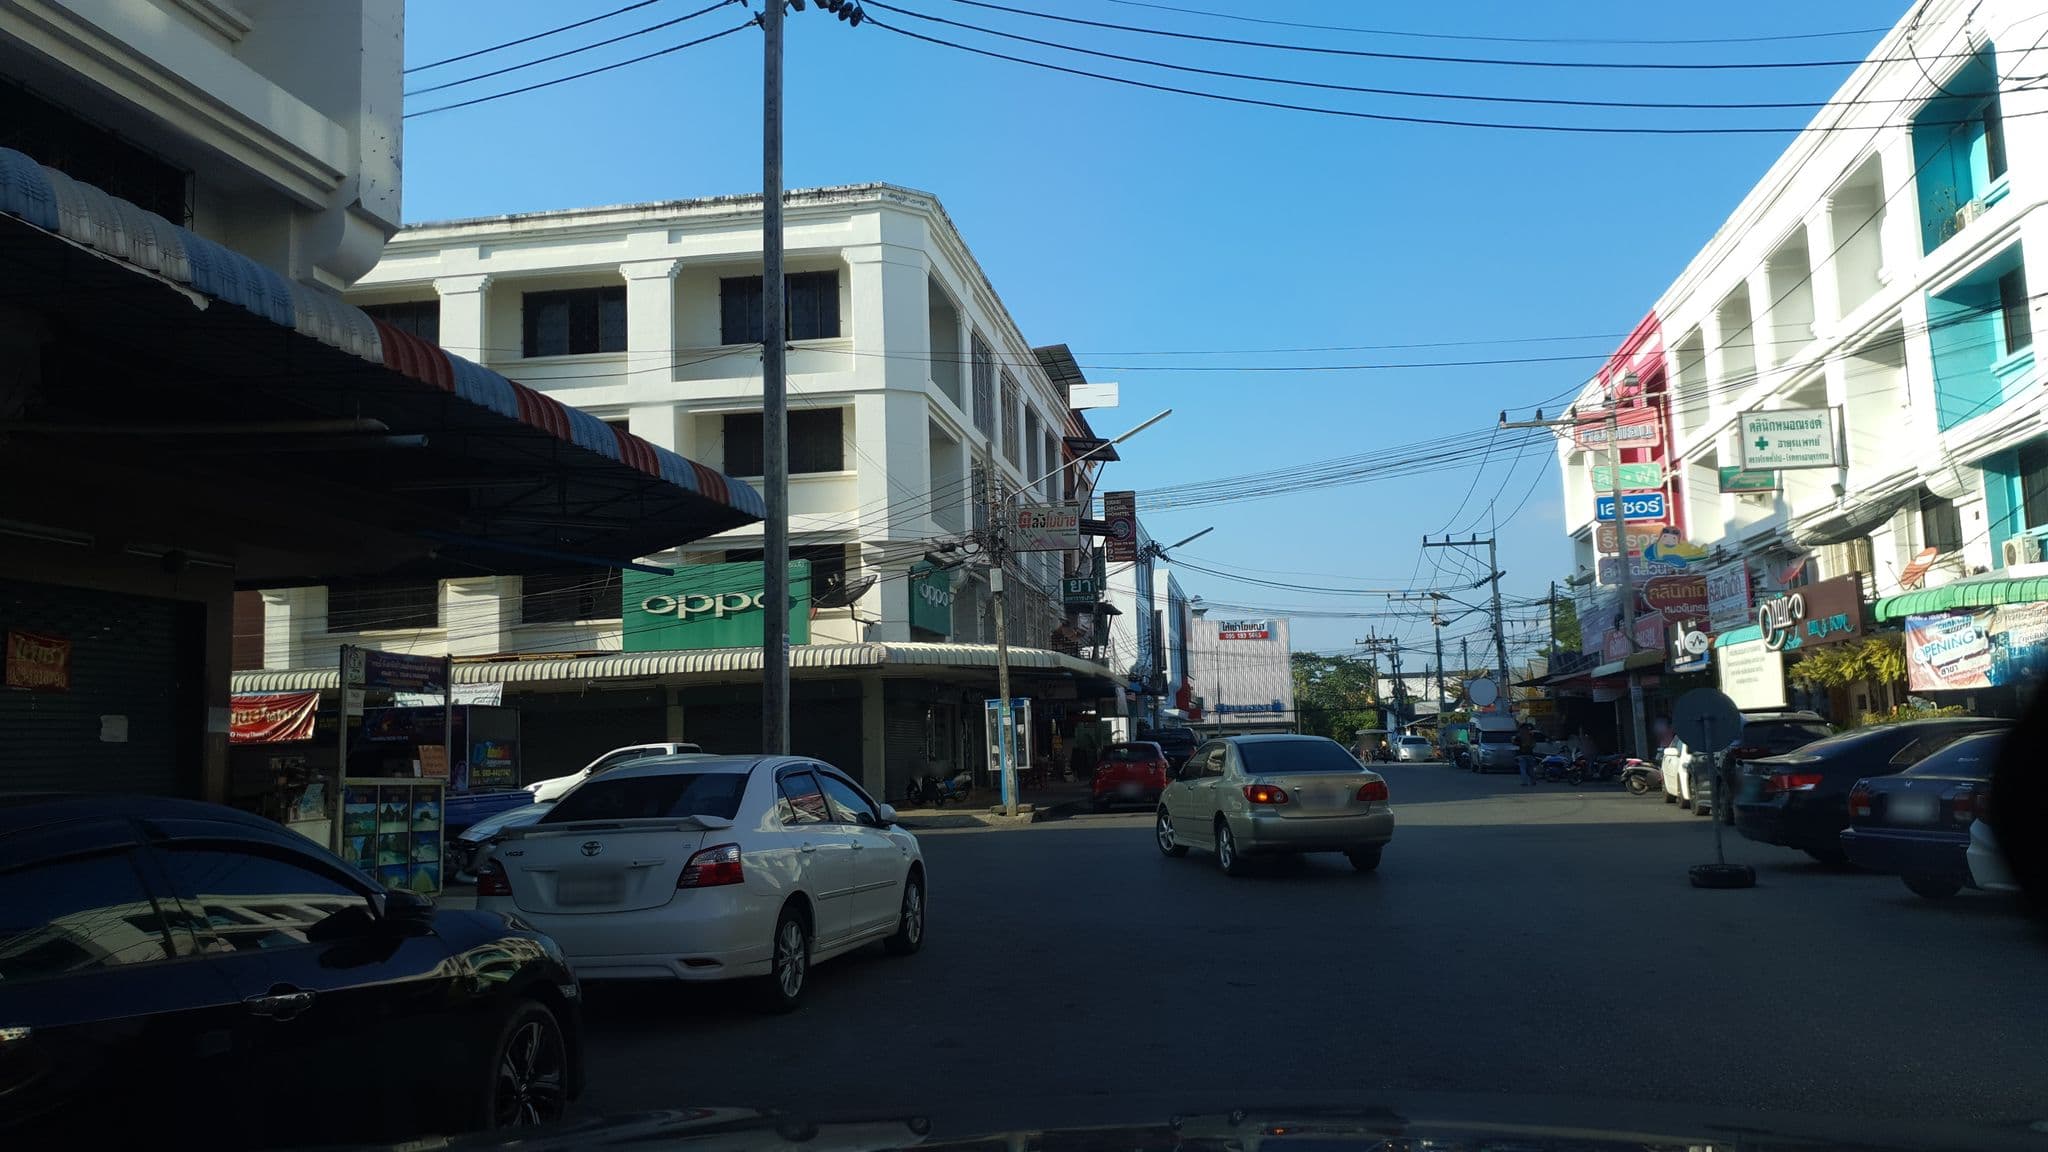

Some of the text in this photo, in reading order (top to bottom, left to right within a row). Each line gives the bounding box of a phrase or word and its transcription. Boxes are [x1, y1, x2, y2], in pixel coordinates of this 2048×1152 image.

[1600, 496, 1661, 516] เลซอร์
[1071, 579, 1091, 592] ยา
[1915, 630, 1975, 661] OPENING
